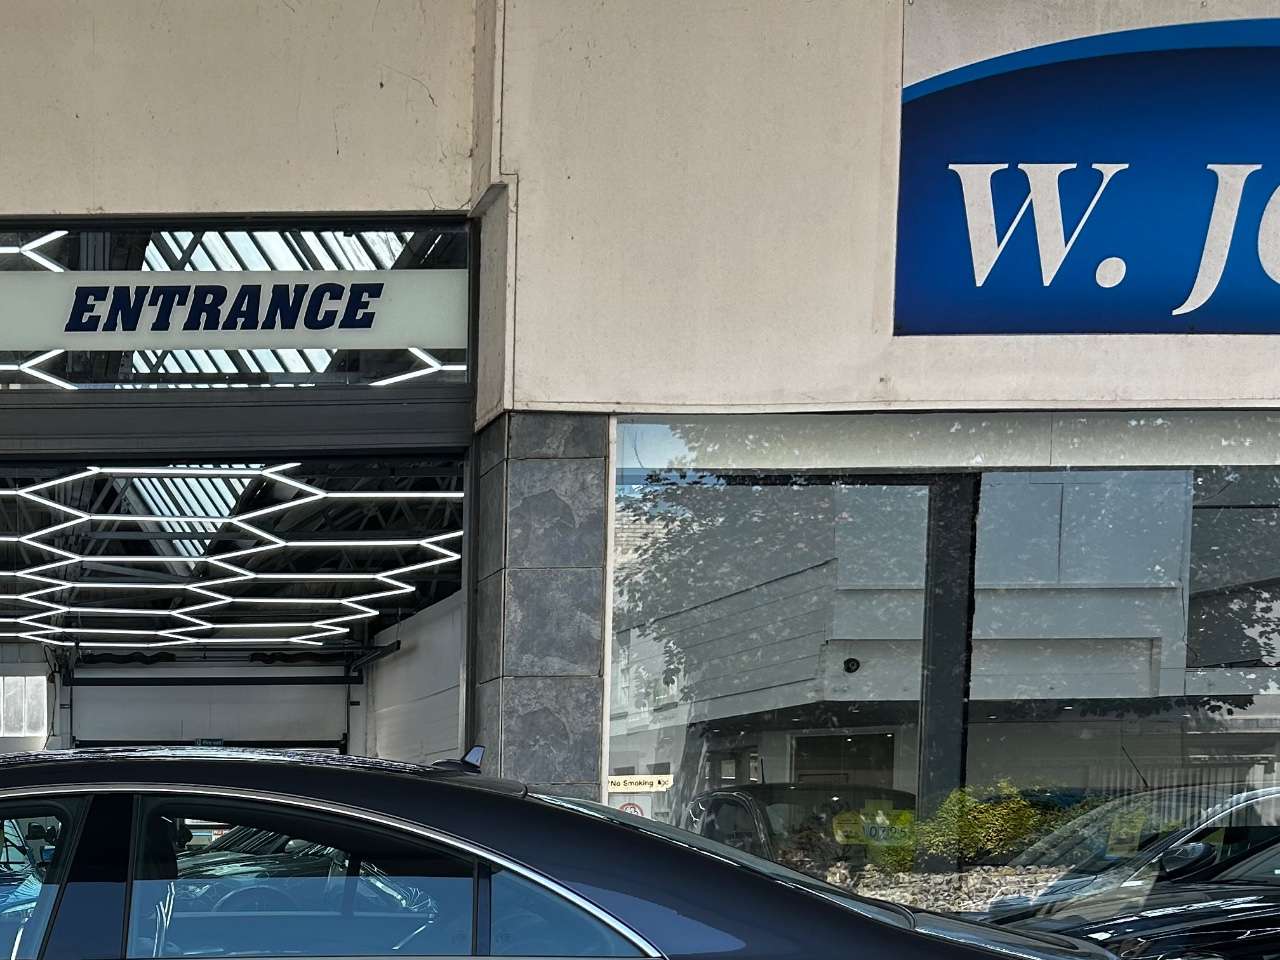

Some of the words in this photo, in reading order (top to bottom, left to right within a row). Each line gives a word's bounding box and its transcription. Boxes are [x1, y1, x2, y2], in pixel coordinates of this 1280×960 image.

[948, 163, 1129, 288] W.
[1172, 163, 1280, 316] J
[64, 282, 385, 332] ENTRANCE
[623, 780, 654, 788] Smoking
